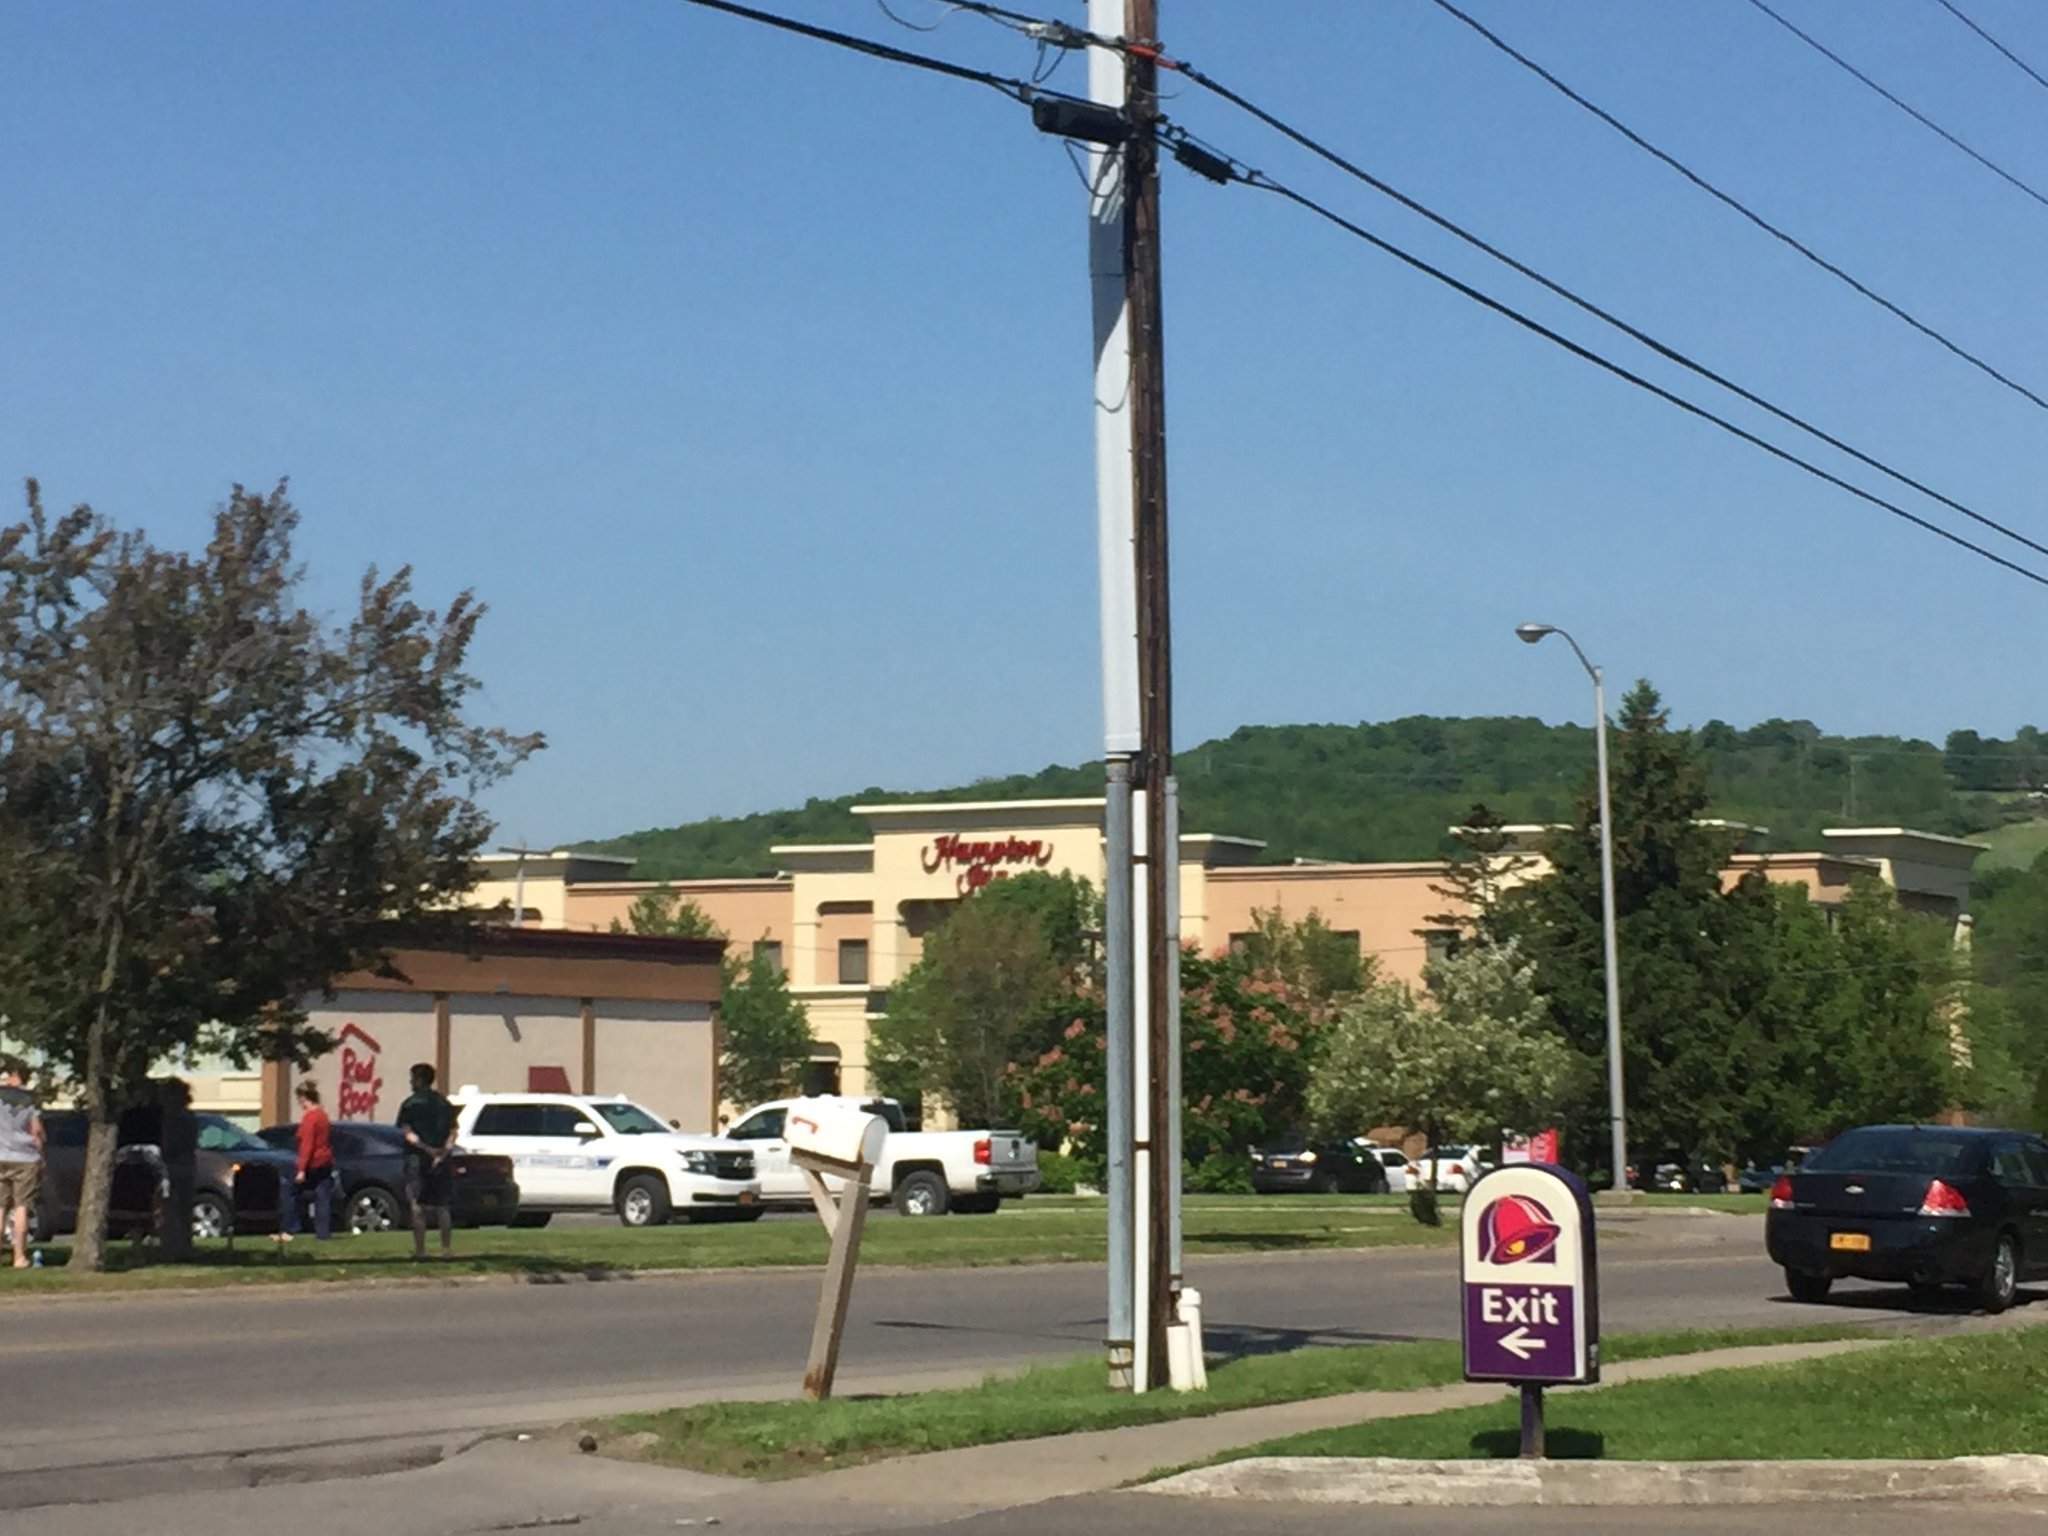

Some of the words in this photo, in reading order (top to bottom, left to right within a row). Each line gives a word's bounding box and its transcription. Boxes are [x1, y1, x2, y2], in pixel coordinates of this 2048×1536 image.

[921, 834, 1054, 874] Hampton
[342, 1047, 376, 1082] Red
[339, 1077, 383, 1121] Roof
[1481, 1287, 1559, 1325] Exit
